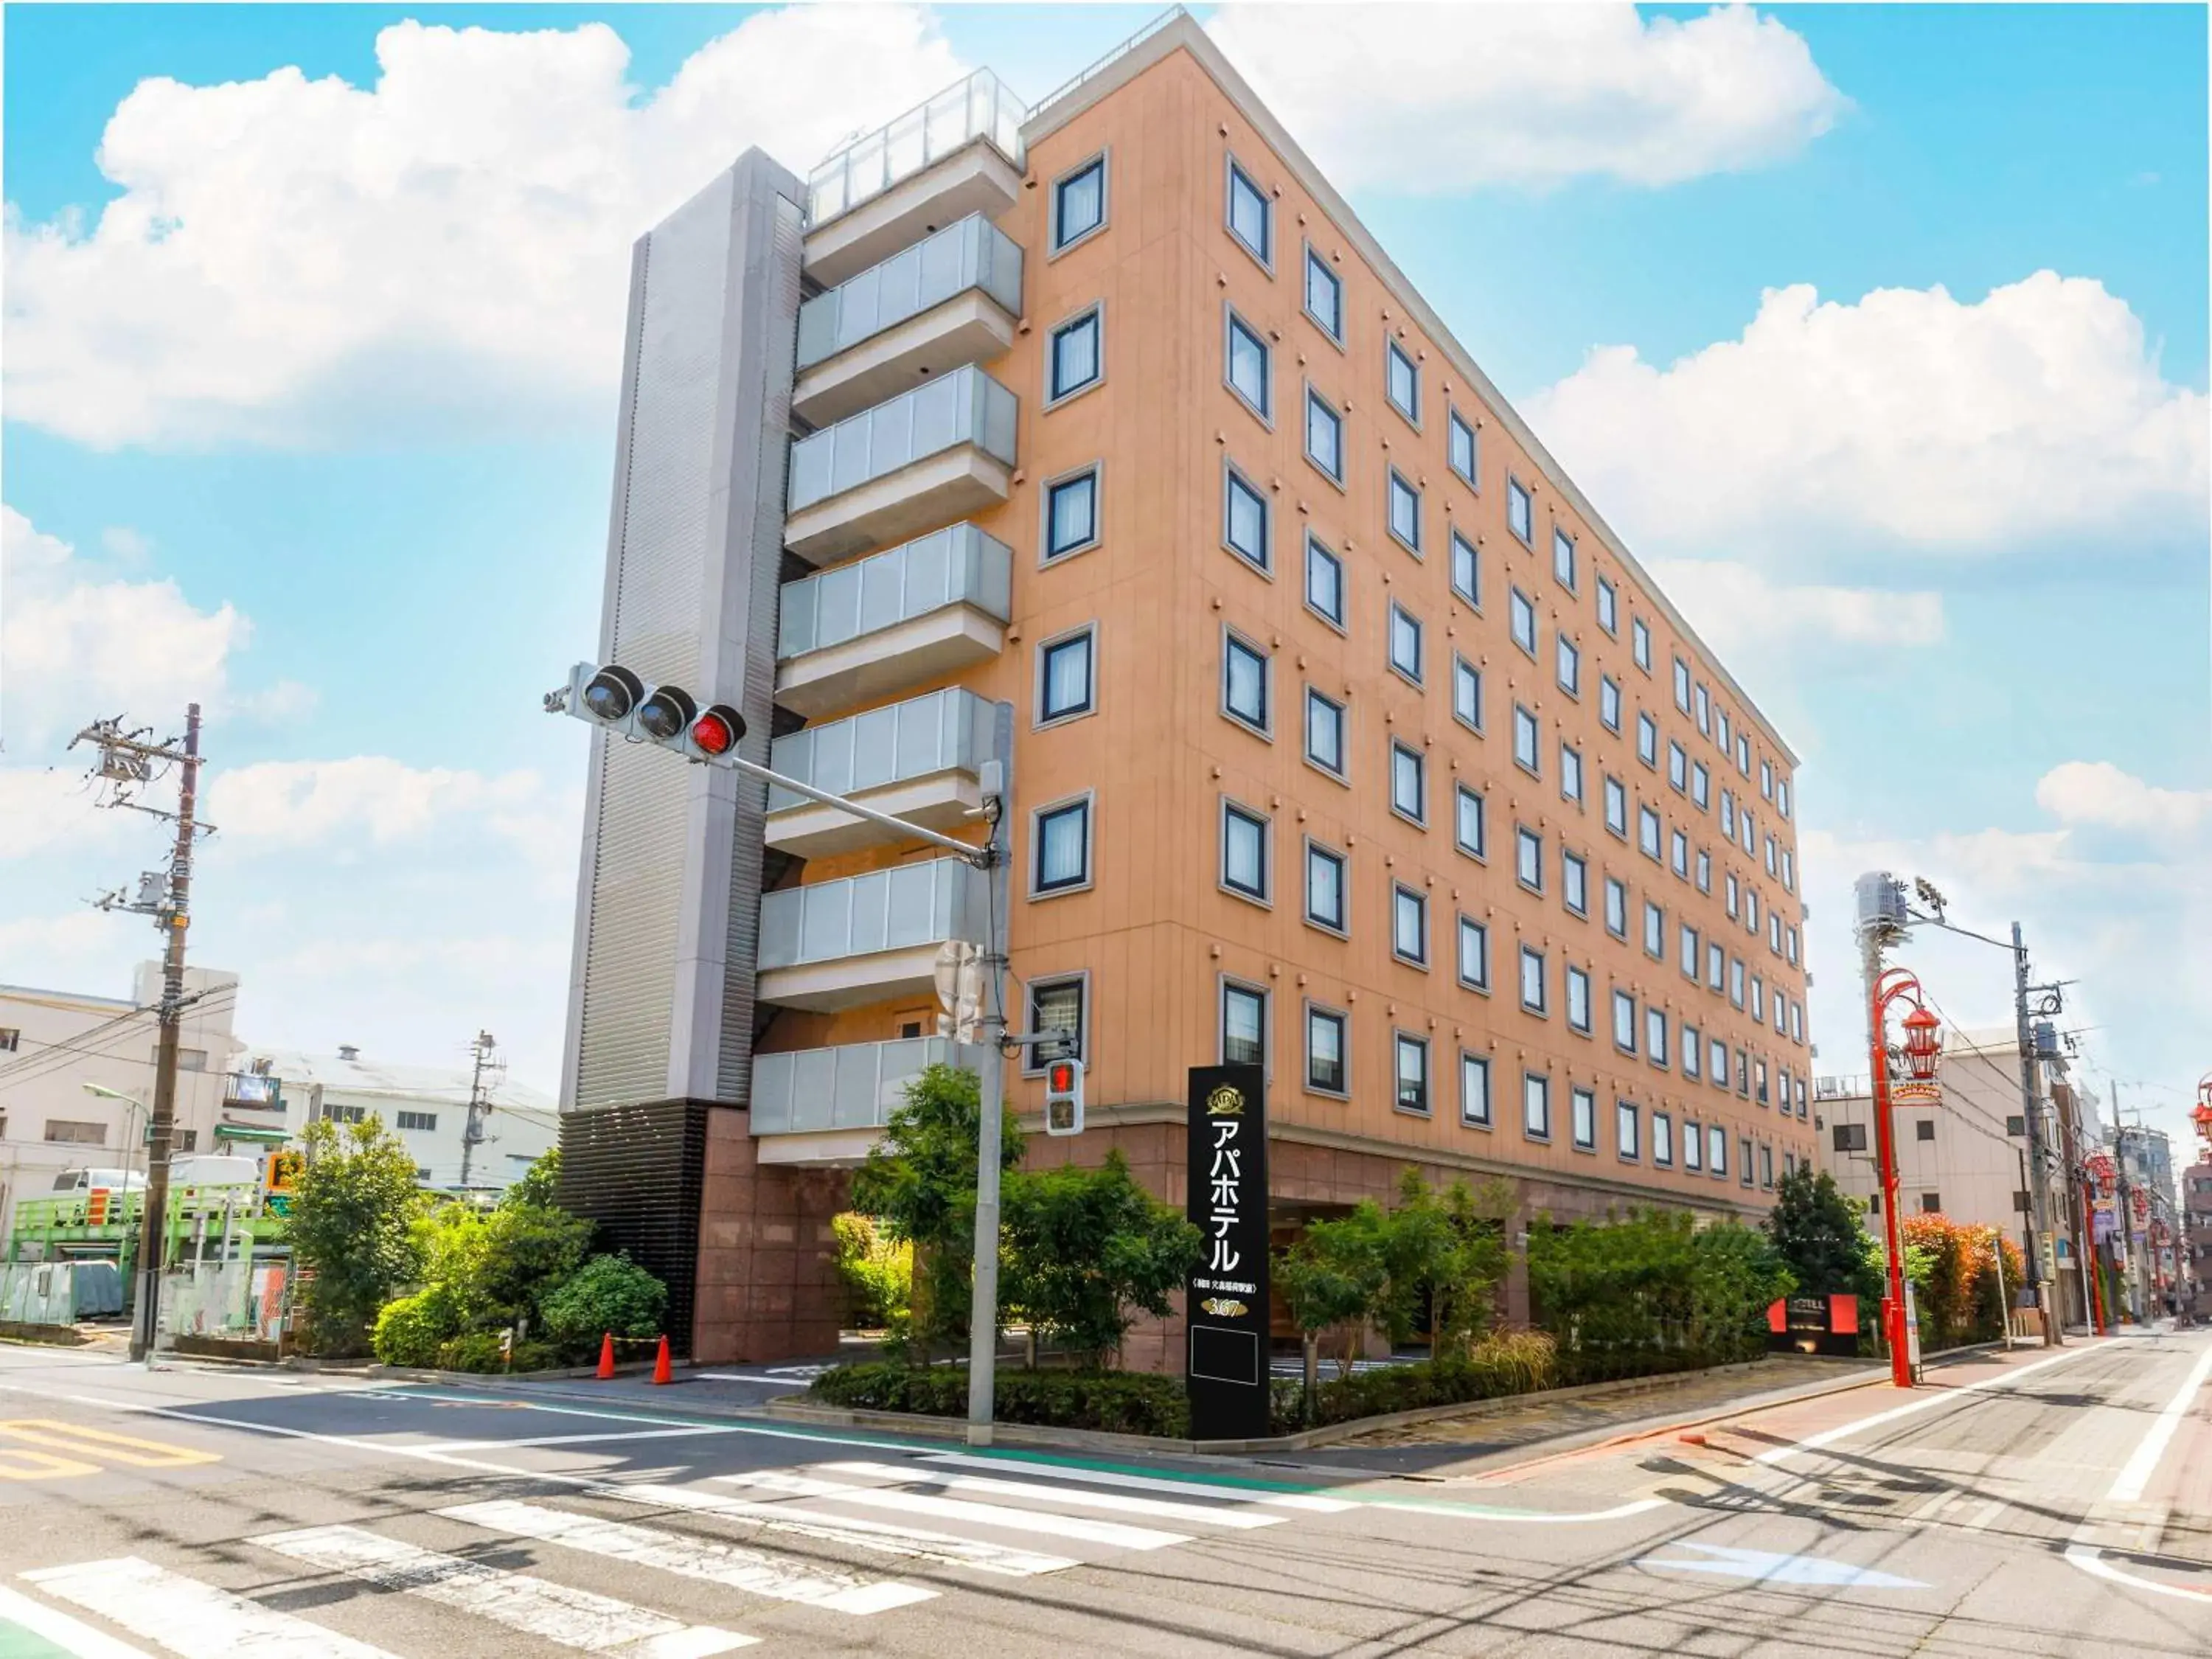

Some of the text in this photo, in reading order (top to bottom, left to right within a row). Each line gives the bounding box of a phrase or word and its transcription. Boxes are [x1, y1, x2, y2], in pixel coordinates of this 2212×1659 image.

[1209, 1121, 1240, 1272] アパホテル
